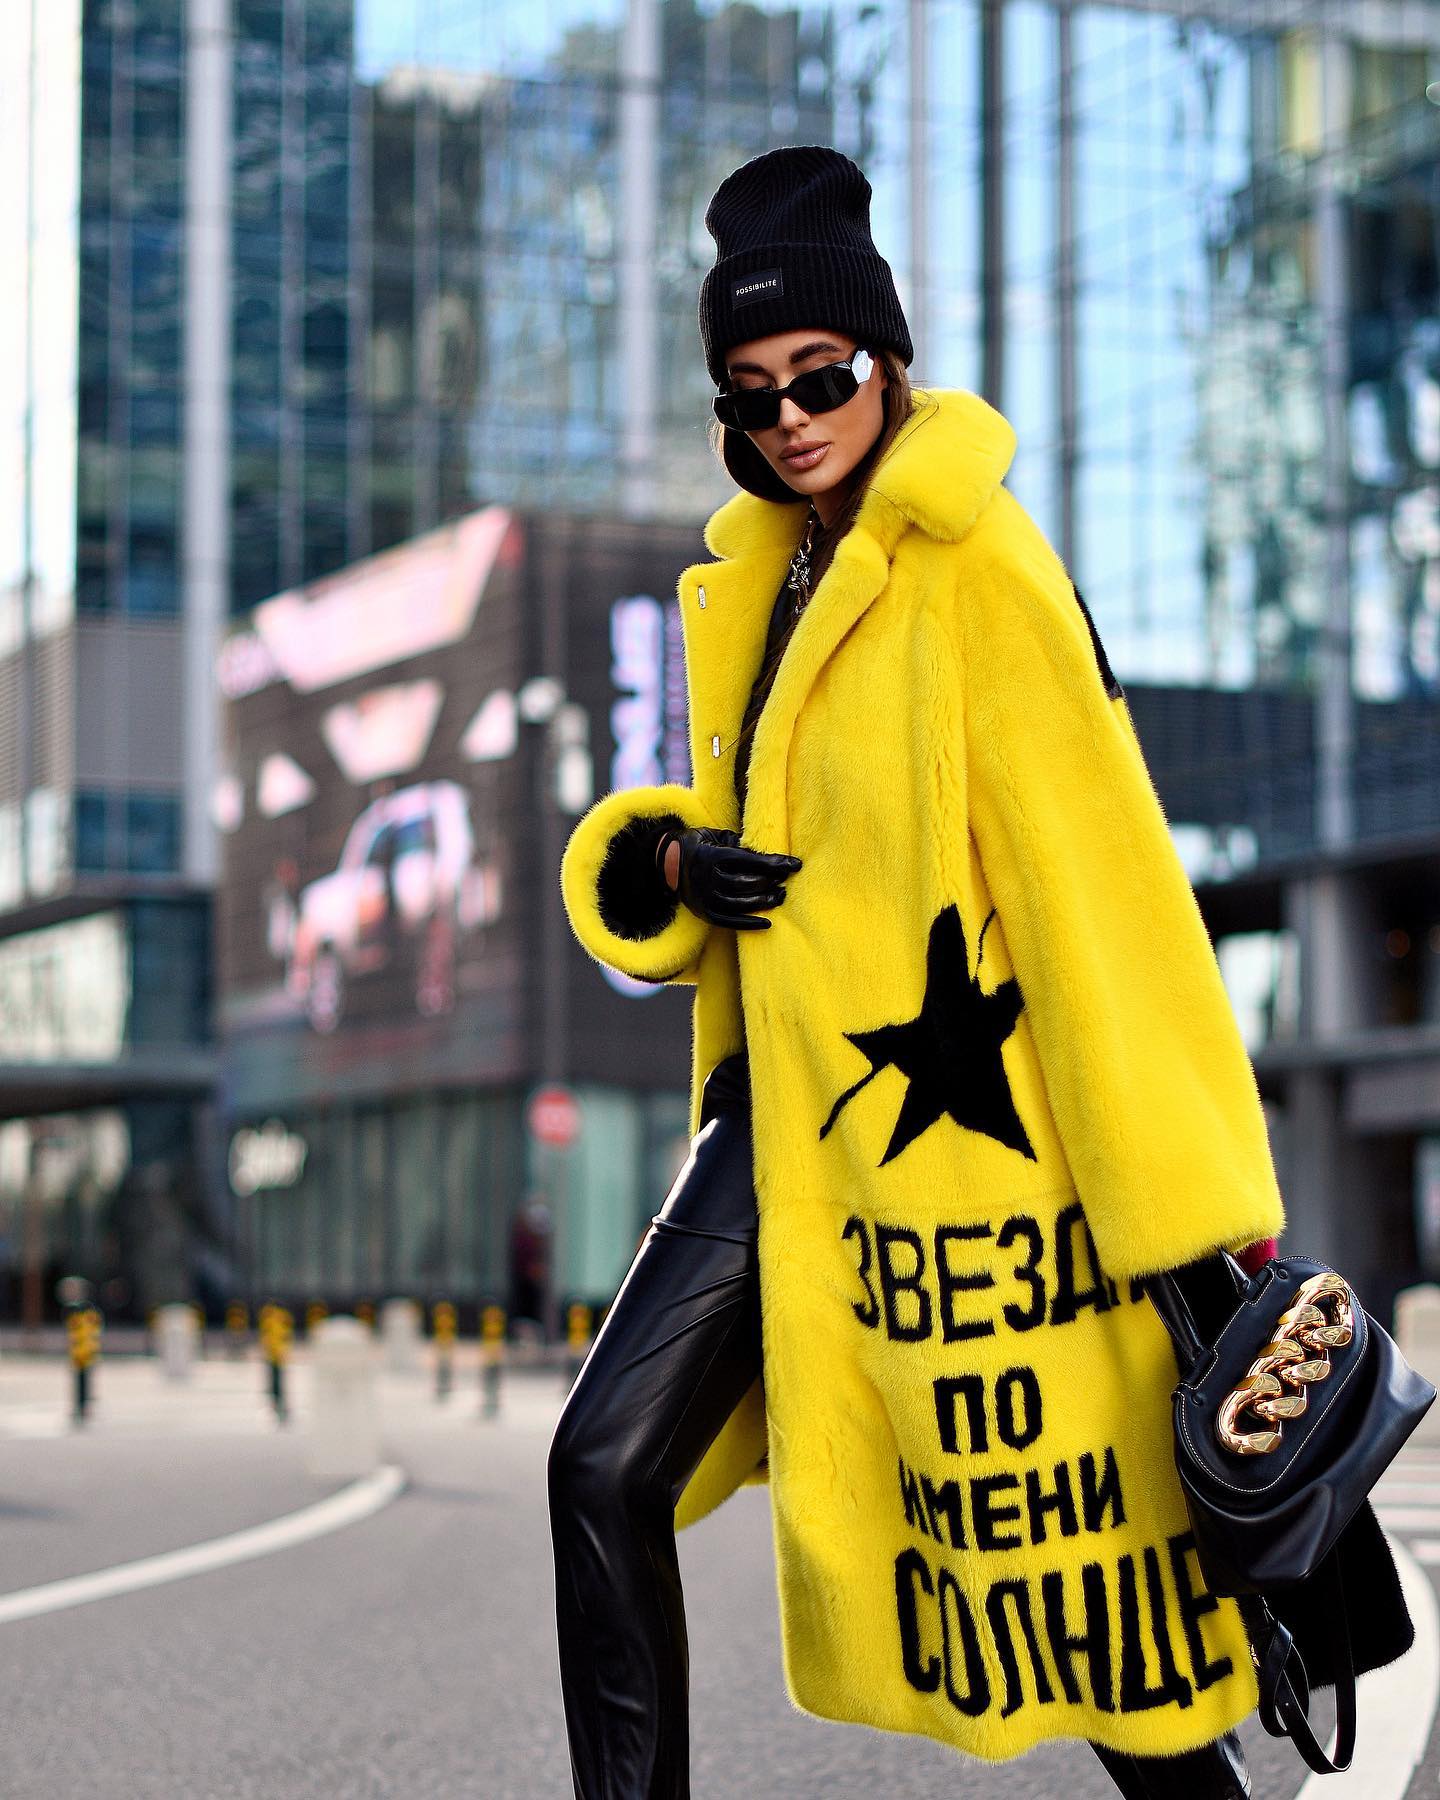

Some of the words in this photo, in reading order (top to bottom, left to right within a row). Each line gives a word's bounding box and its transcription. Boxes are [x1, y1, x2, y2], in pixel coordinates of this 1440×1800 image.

[841, 1203, 1145, 1344] ЗВЕЗД
[933, 1366, 1042, 1454] ПО
[899, 1446, 1127, 1551] ИМЕНИ
[895, 1532, 1234, 1718] СОЛНЦЕ
